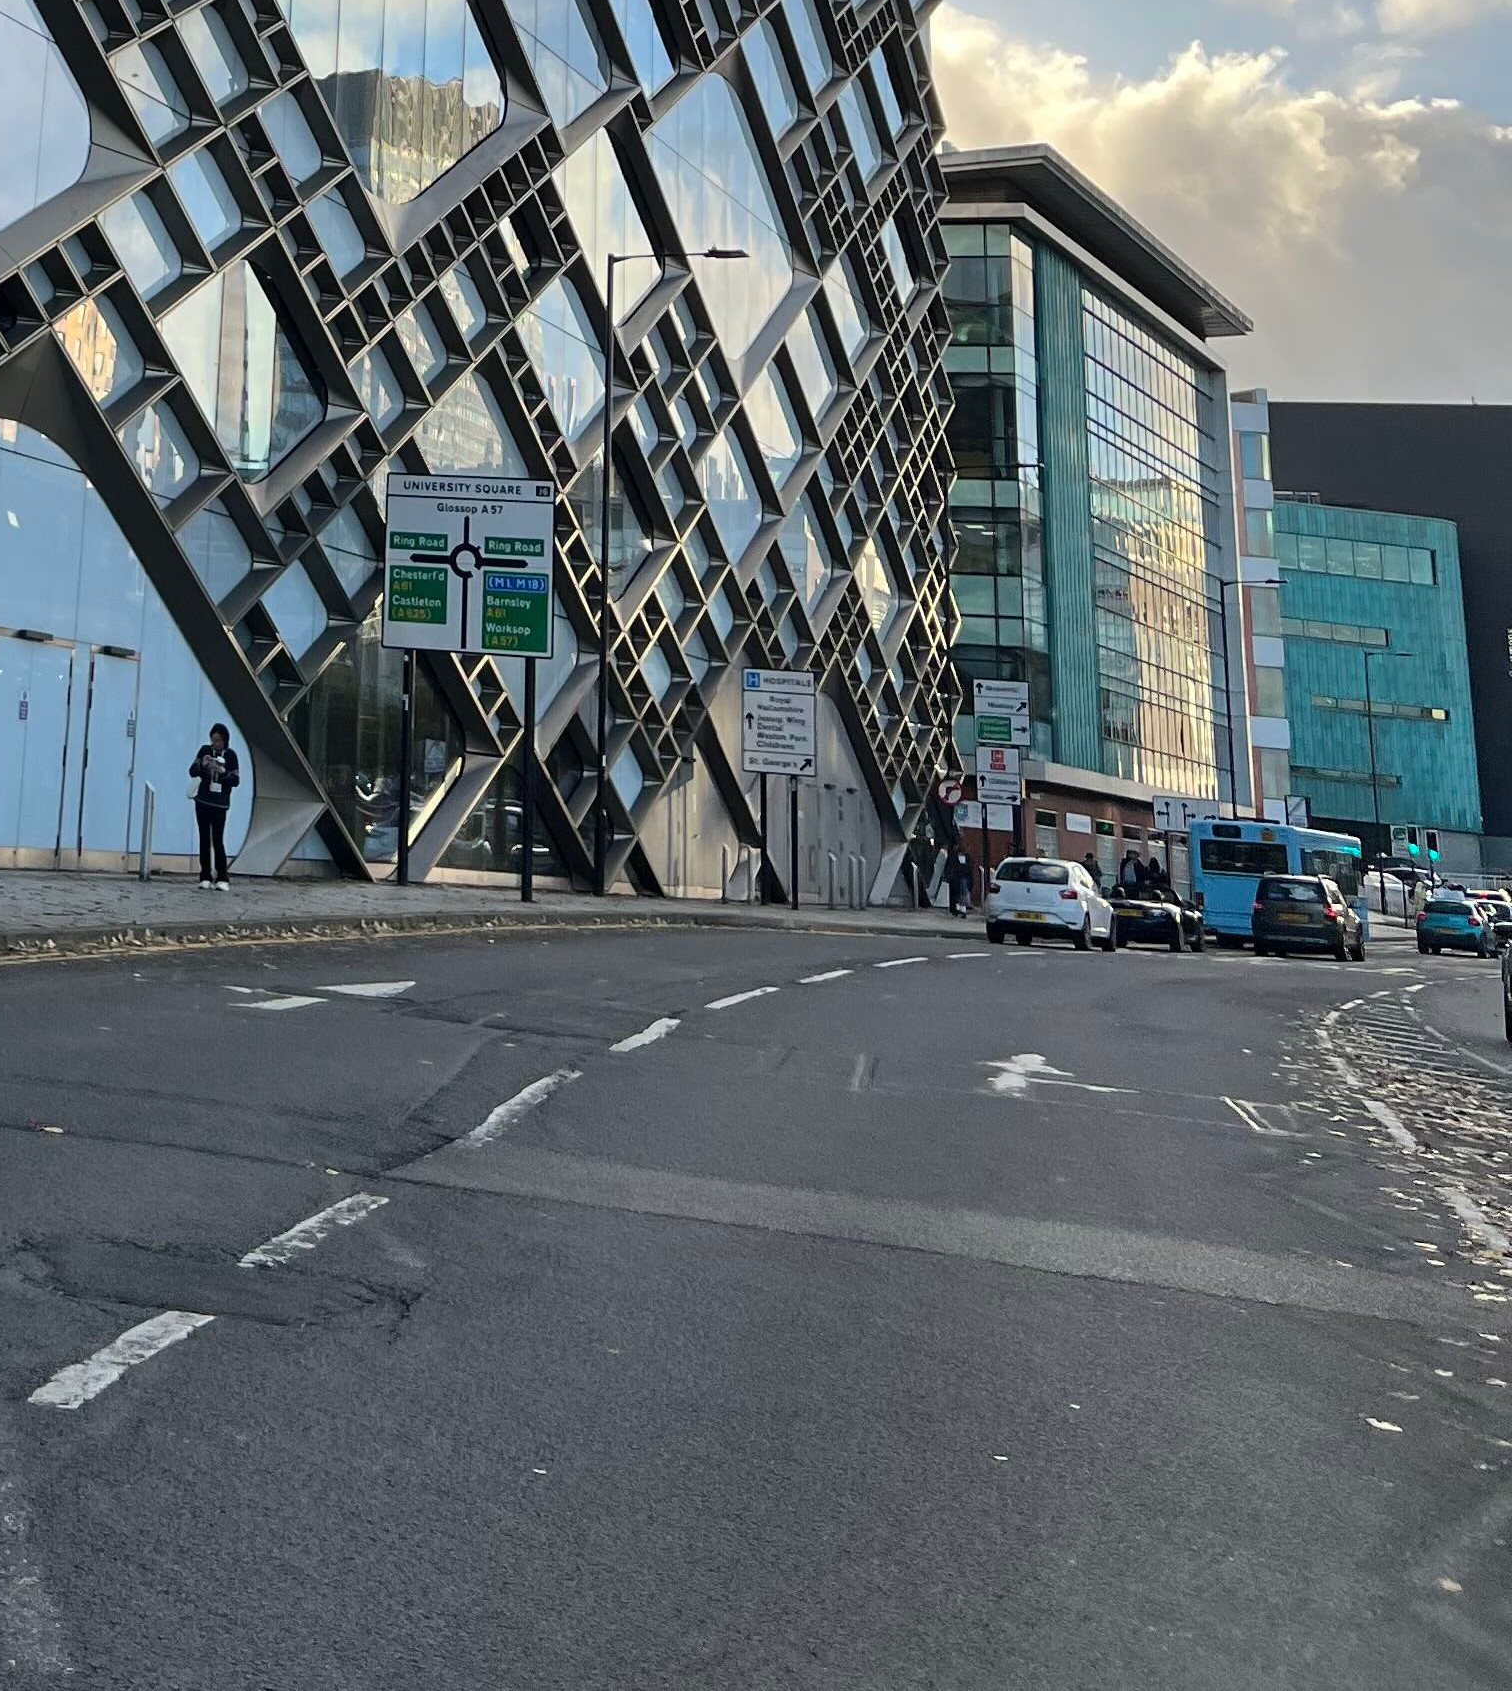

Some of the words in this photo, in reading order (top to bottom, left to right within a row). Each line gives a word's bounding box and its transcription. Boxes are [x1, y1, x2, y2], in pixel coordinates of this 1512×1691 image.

[403, 480, 471, 492] UNIVERSITY
[474, 483, 522, 495] SQUARE
[437, 502, 478, 515] Glossop
[393, 535, 415, 548] Ring
[418, 536, 445, 548] Road
[488, 540, 511, 553] Ring
[514, 541, 541, 553] Road
[392, 594, 442, 608] Castleton
[486, 595, 532, 610] Barnsley
[485, 622, 531, 636] Worksop
